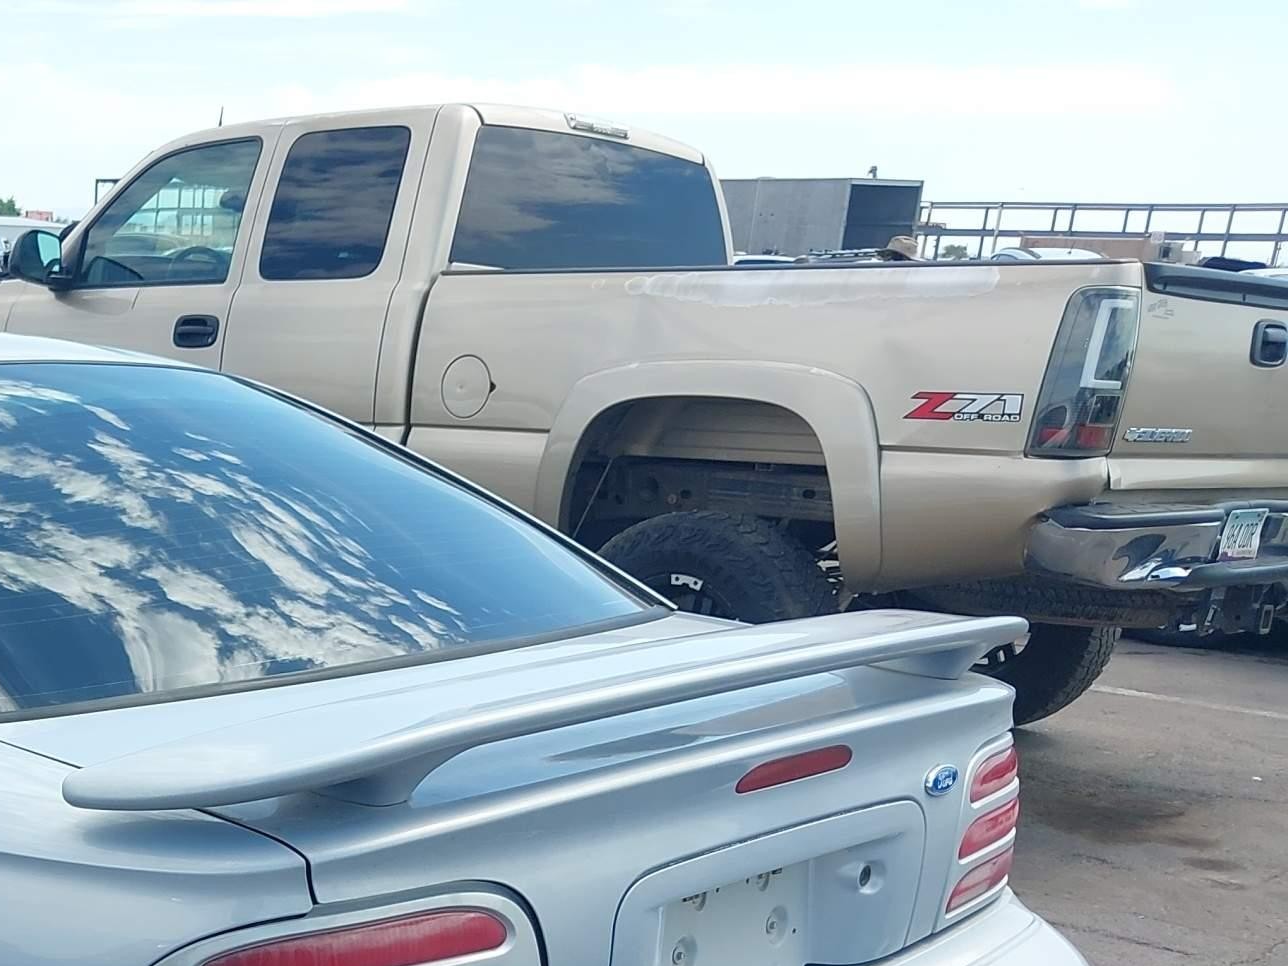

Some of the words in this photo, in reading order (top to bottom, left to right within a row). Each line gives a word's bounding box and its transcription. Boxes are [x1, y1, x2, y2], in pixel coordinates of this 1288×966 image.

[902, 391, 1024, 420] Z71
[953, 413, 979, 421] OFF
[983, 413, 1021, 421] ROAD
